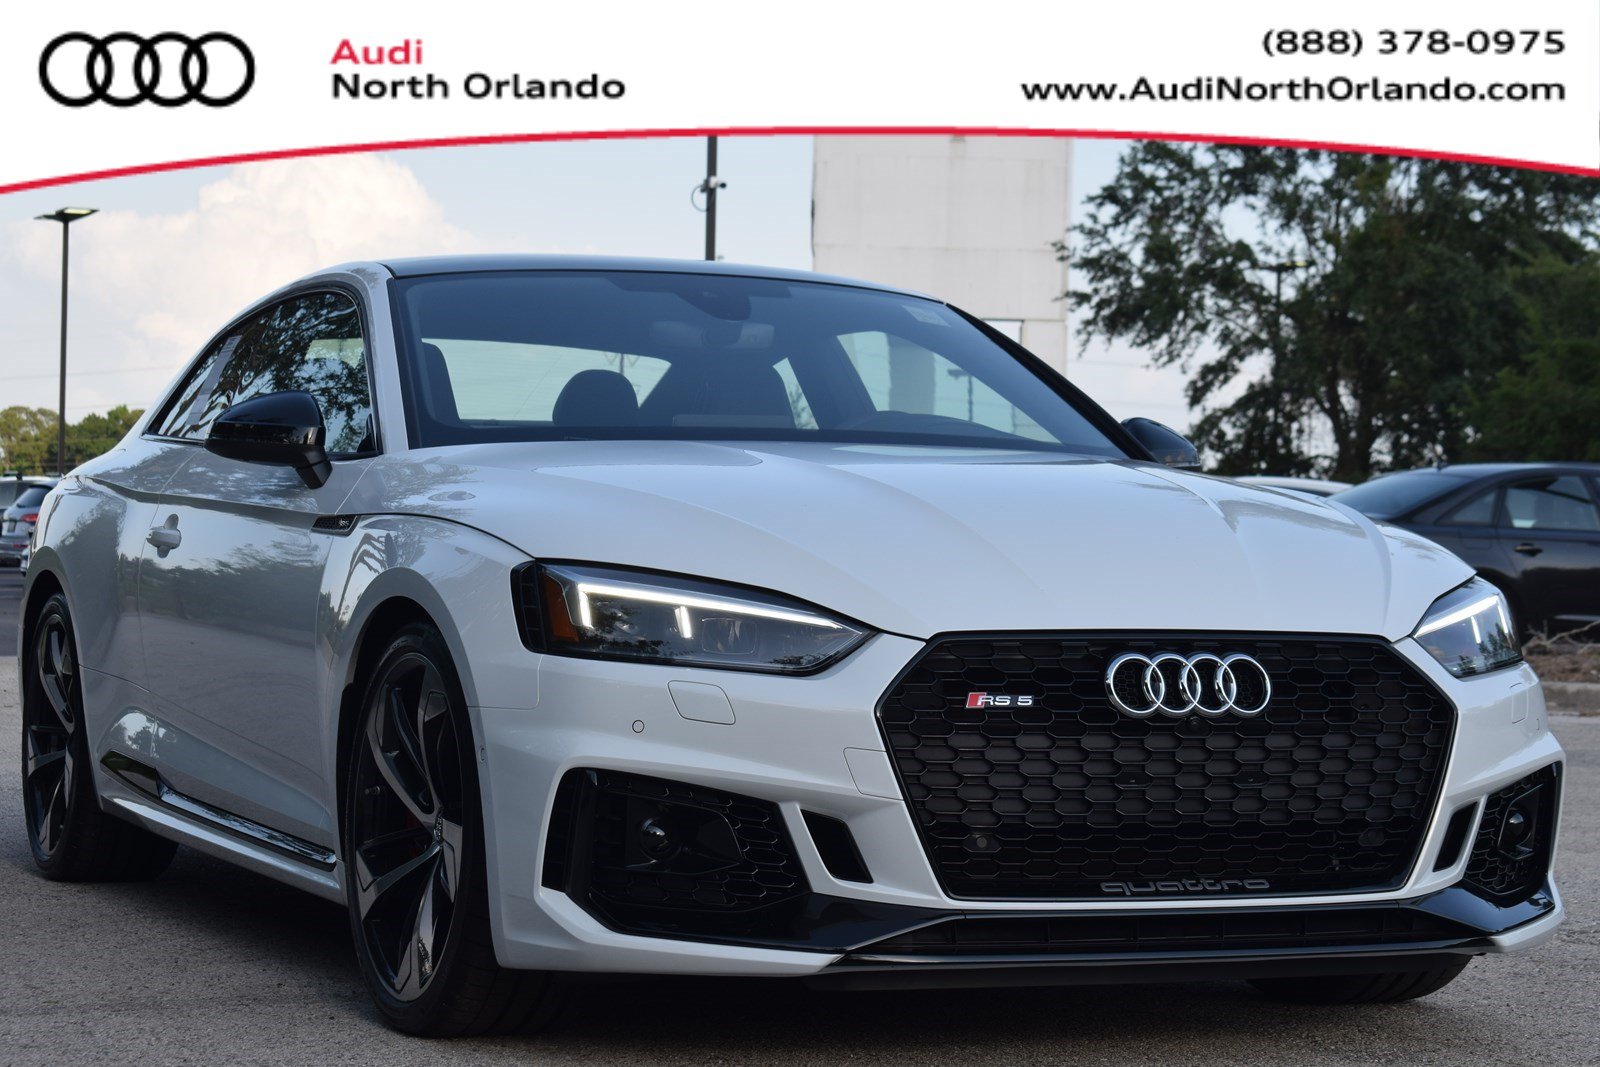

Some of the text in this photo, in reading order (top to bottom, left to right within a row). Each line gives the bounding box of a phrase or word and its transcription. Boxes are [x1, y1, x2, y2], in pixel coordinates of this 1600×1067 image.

[976, 695, 1033, 706] RS 5
[1099, 877, 1271, 896] quattro
